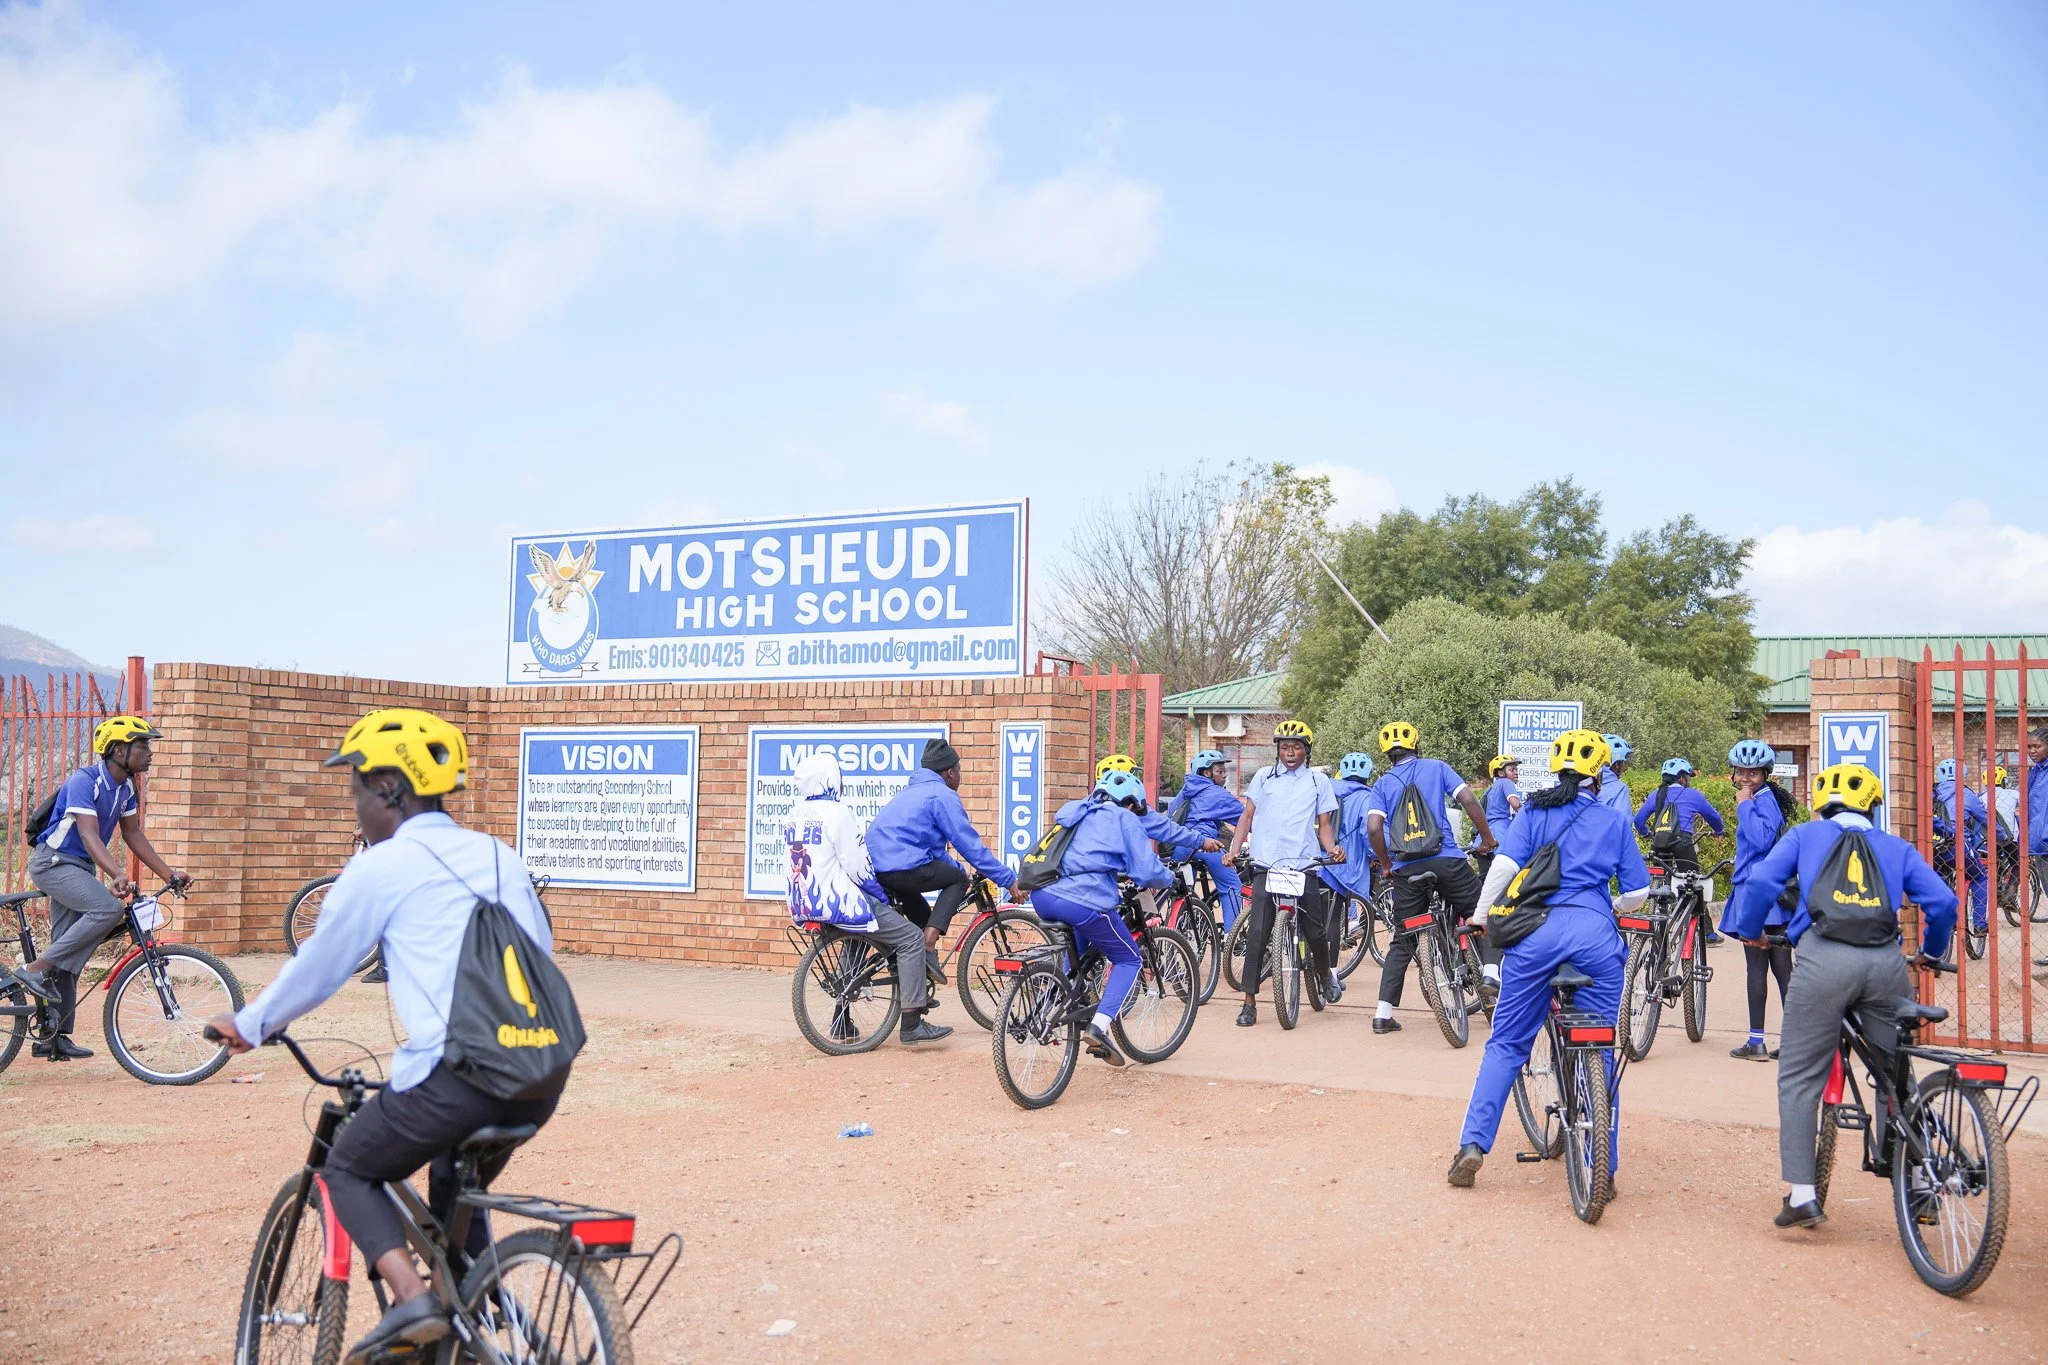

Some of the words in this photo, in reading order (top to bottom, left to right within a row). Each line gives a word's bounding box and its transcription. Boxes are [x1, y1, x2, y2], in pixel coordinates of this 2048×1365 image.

[629, 524, 969, 593] MOTSHEUDI
[675, 593, 774, 630] HIGH
[794, 584, 968, 625] SCHOOL
[531, 633, 549, 660] WHO
[548, 651, 577, 666] DARES
[576, 630, 595, 658] WINS
[787, 634, 1016, 670] abithamod@gmail.com
[1509, 710, 1573, 729] MOTSHEUDI
[1508, 729, 1531, 740] HIGH
[561, 744, 654, 771] VISION
[1520, 756, 1547, 767] arking
[1518, 768, 1558, 778] Classroo
[528, 779, 536, 793] To
[537, 779, 545, 793] be
[547, 782, 555, 793] an
[557, 779, 603, 797] outstanding
[605, 779, 645, 797] Secondary
[647, 779, 671, 794] School
[757, 780, 792, 796] Provide
[856, 780, 886, 797] which
[1516, 780, 1543, 789] oilets
[528, 797, 550, 812] where
[551, 798, 582, 812] learners
[584, 801, 597, 812] are
[600, 798, 621, 815] given
[622, 801, 645, 815] every
[647, 799, 691, 818] opportunity
[756, 800, 795, 817] approac
[856, 805, 867, 817] on
[528, 816, 537, 830] to
[537, 816, 569, 830] succeed
[571, 816, 580, 833] by
[583, 816, 624, 835] developing
[625, 817, 634, 832] to
[636, 817, 649, 832] the
[651, 818, 665, 832] full
[667, 818, 676, 833] of
[756, 819, 776, 835] their
[527, 834, 547, 849] their
[549, 835, 589, 850] academic
[591, 835, 606, 850] and
[608, 836, 650, 851] vocational
[652, 837, 687, 854] abilities,
[803, 827, 822, 845] 26
[527, 853, 556, 867] creative
[558, 854, 585, 868] talents
[587, 855, 602, 868] and
[605, 856, 642, 874] sporting
[643, 856, 683, 871] interests
[754, 859, 764, 874] to
[765, 859, 775, 874] fit
